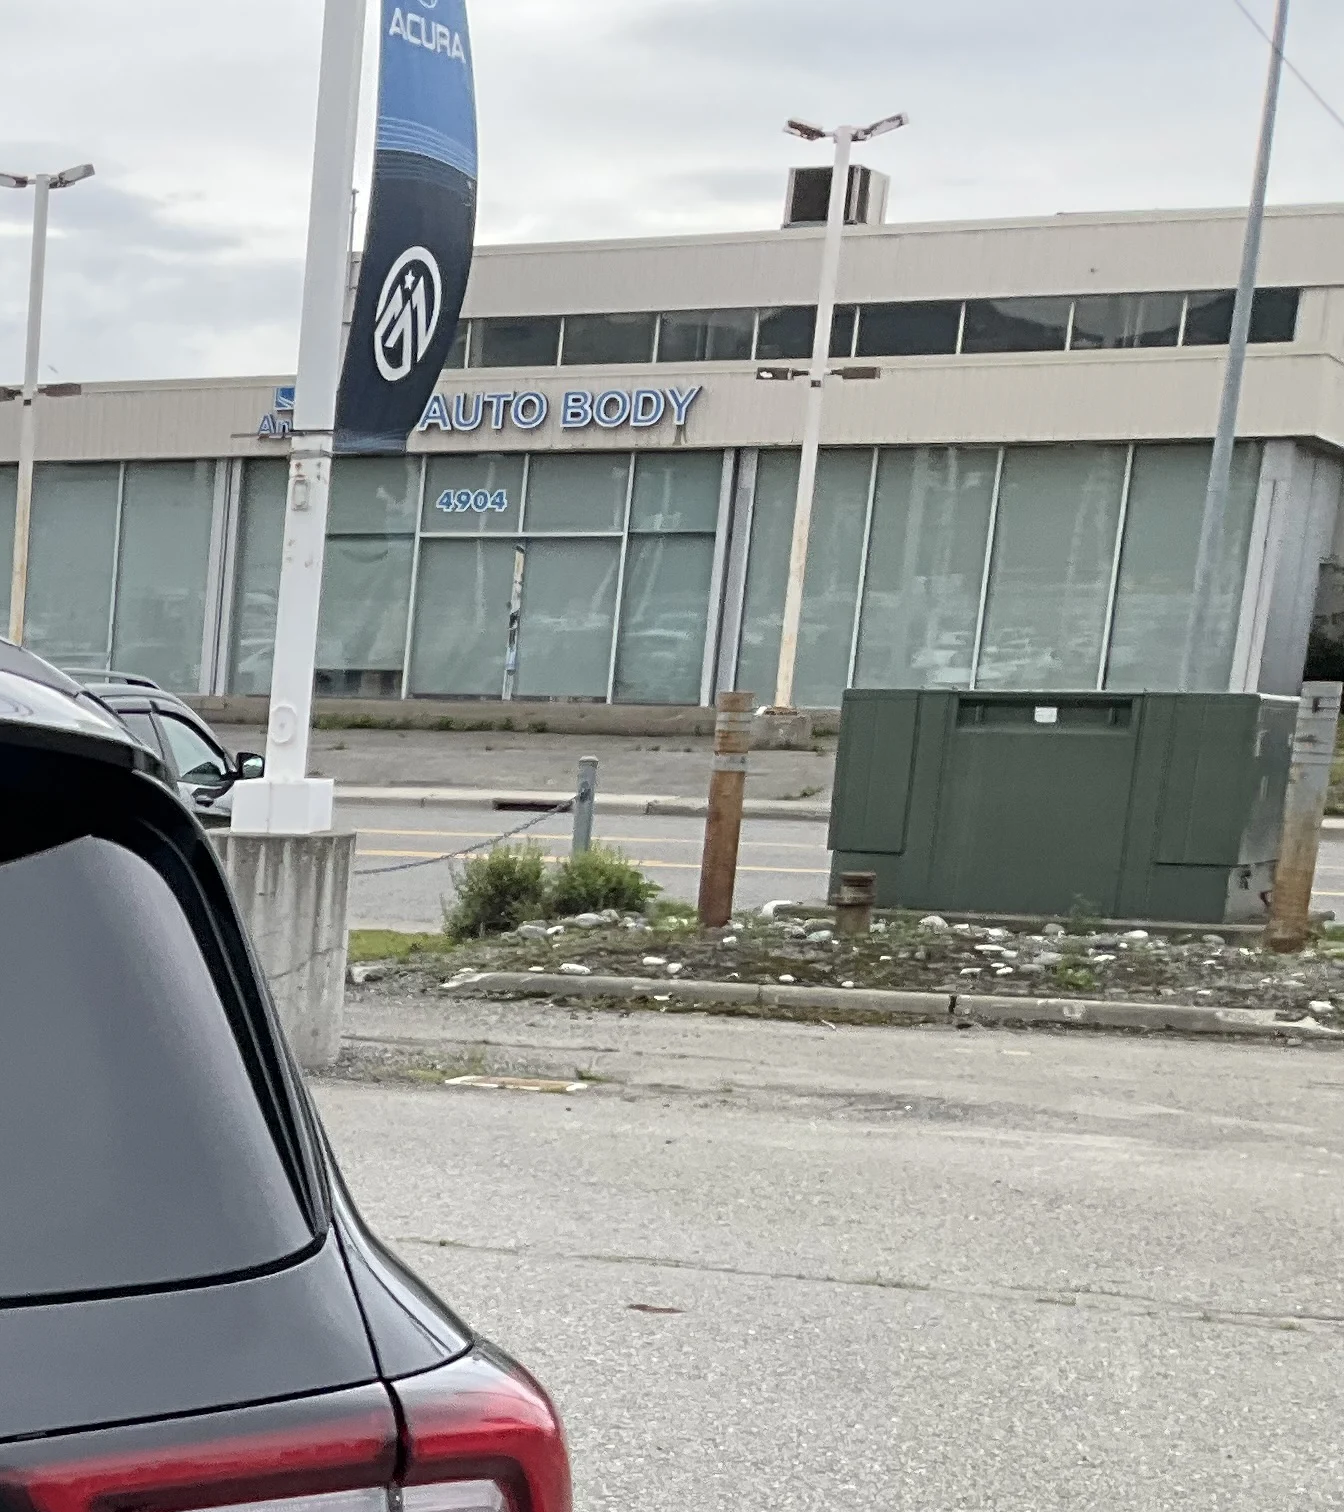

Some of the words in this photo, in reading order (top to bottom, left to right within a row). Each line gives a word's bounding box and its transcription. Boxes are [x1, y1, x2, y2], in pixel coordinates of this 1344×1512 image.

[388, 7, 467, 64] ACURA
[417, 391, 548, 431] AUTO
[561, 385, 703, 428] BODY
[436, 489, 508, 513] 4904
